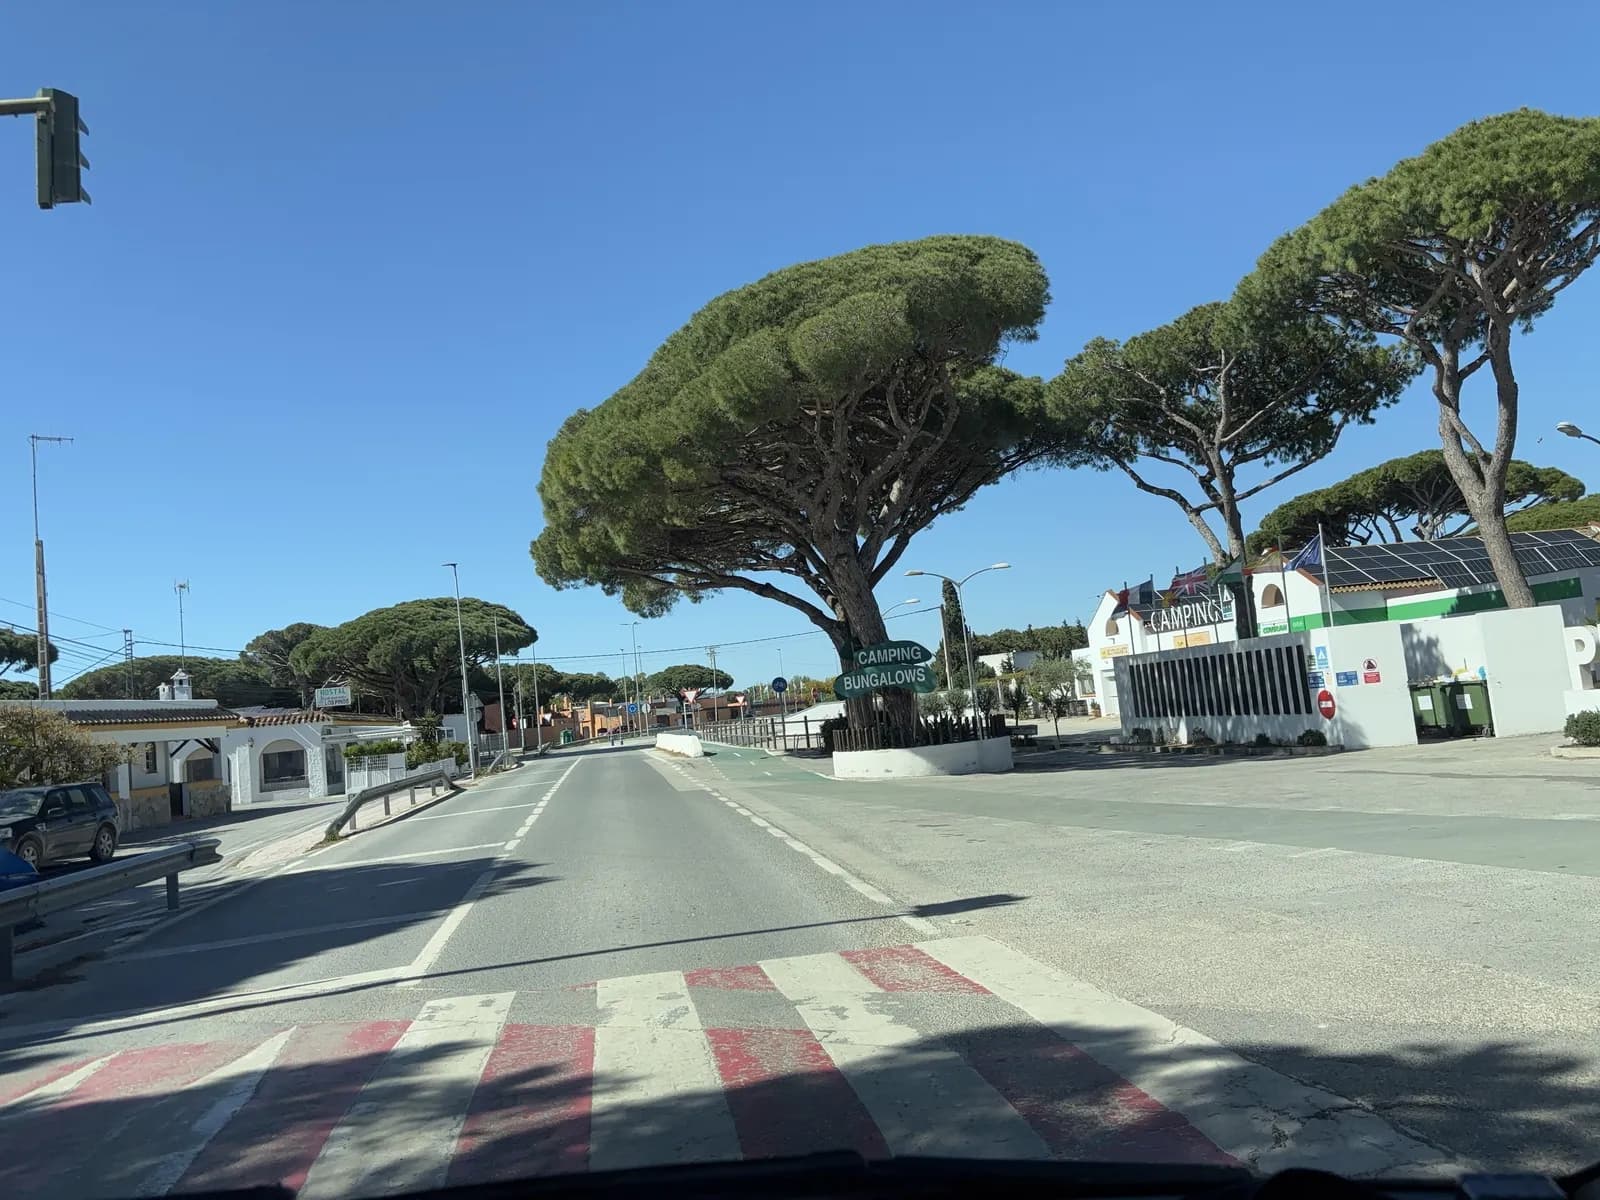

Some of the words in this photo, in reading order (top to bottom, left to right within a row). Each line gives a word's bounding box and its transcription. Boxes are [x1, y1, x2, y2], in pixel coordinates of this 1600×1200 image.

[1150, 601, 1223, 632] CAMPING
[858, 646, 922, 665] CAMPING
[843, 668, 926, 690] BUNGALOWS
